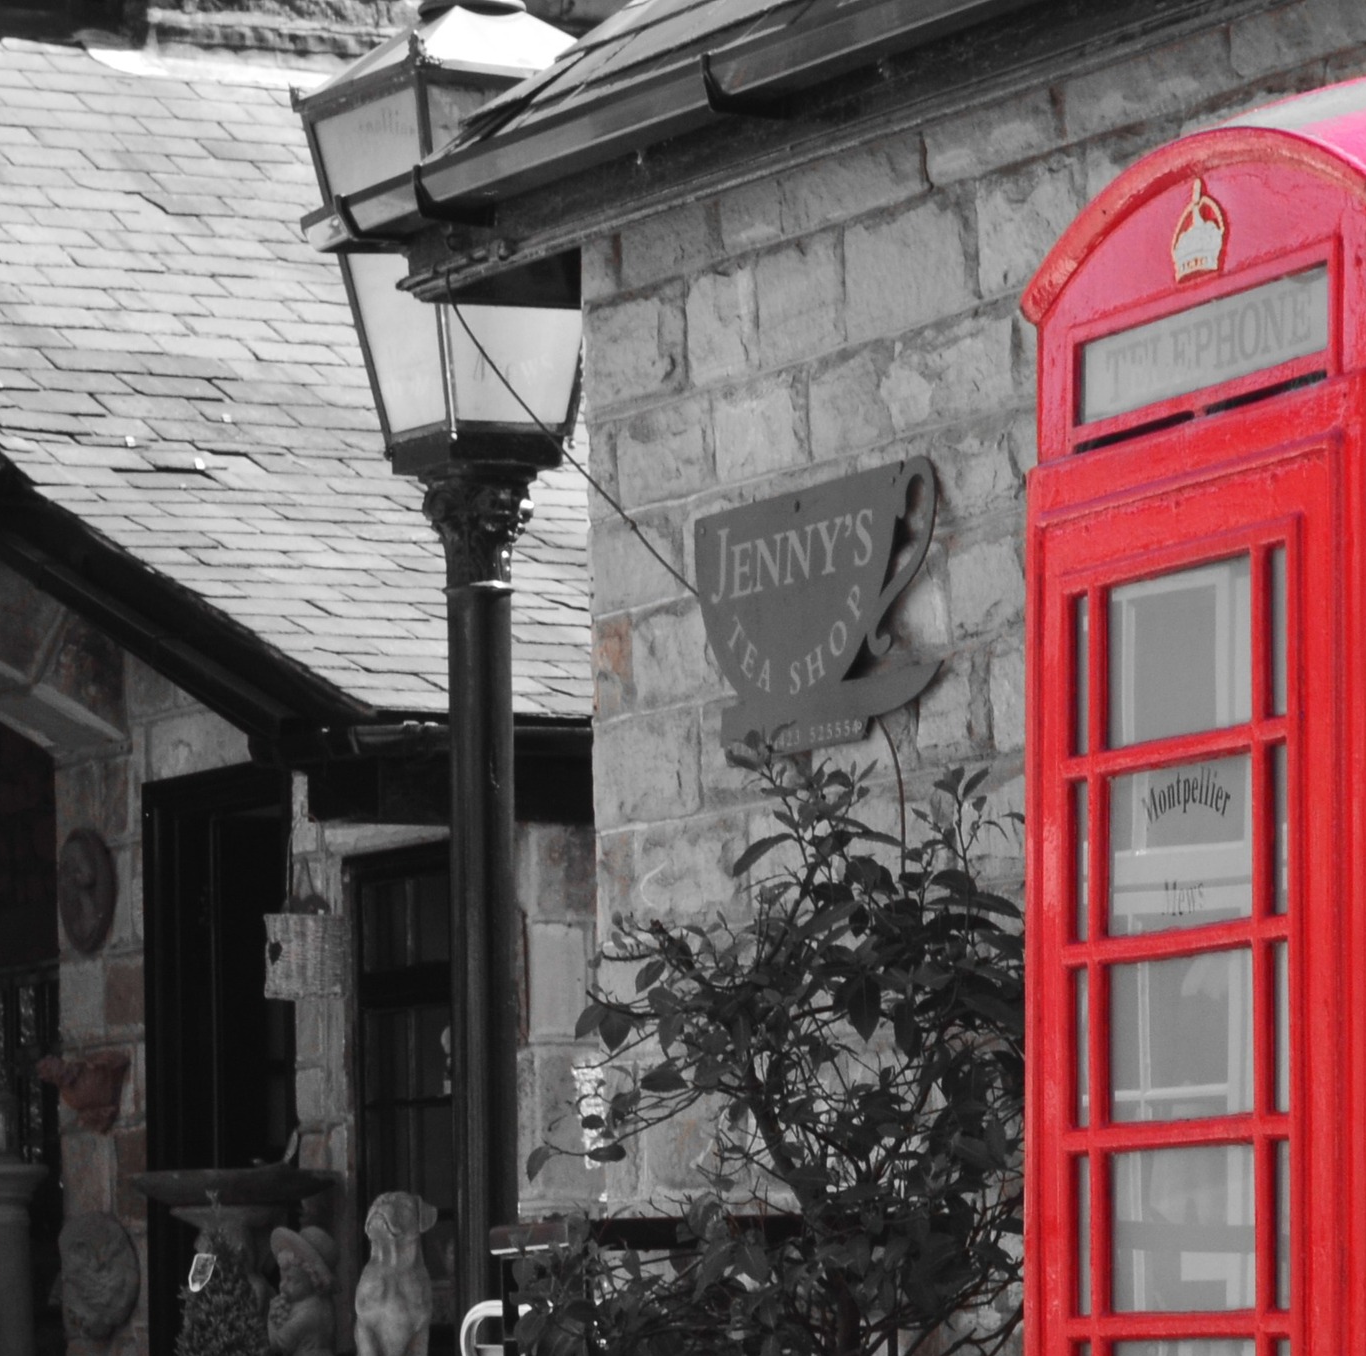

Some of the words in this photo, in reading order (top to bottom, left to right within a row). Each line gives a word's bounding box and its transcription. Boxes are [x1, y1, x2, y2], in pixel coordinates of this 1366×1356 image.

[1104, 286, 1315, 404] TELEPHONE
[711, 508, 873, 604] JENNY'S
[727, 615, 771, 692] TEA
[789, 584, 863, 695] SHOP
[1141, 765, 1232, 824] Montpellier
